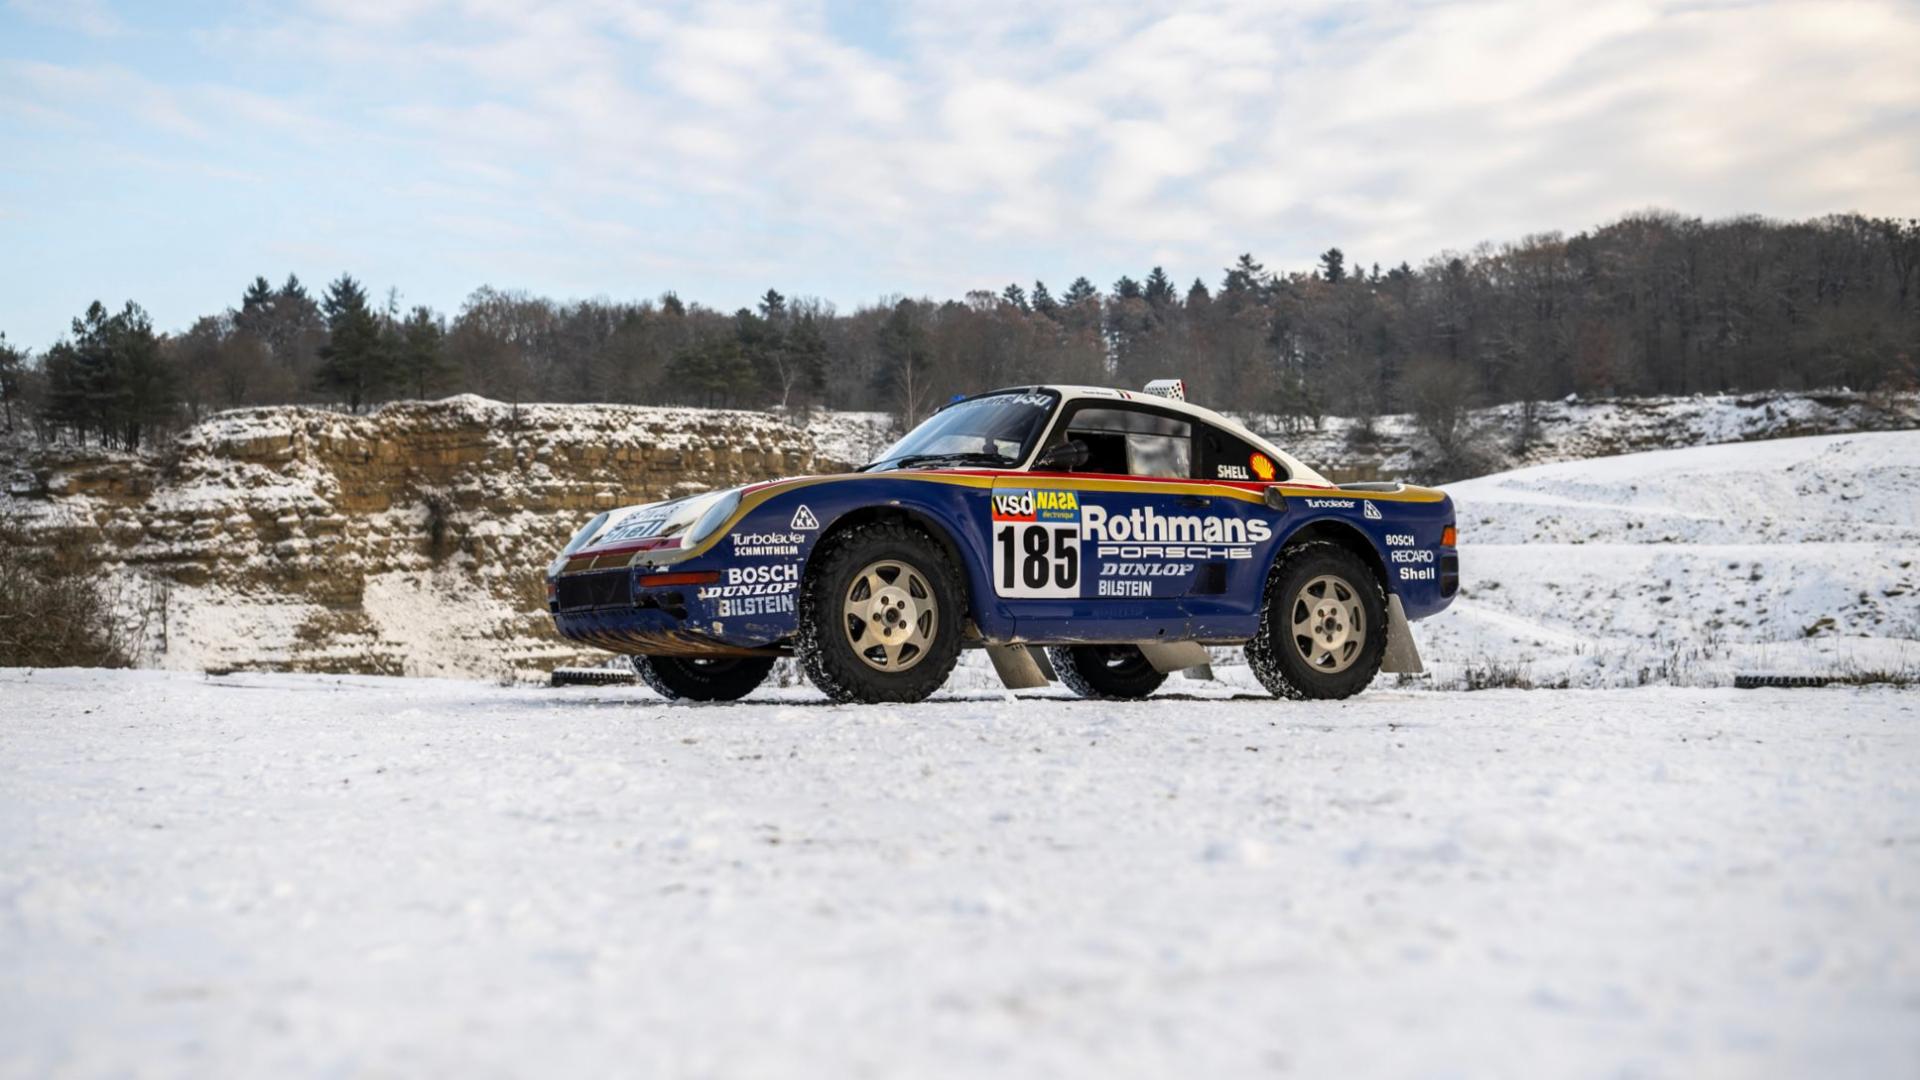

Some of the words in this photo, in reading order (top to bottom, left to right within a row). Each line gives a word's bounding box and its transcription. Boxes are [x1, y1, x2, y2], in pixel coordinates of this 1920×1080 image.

[1217, 464, 1249, 479] SHELL
[993, 490, 1034, 516] vsd
[1081, 505, 1272, 542] Rothmans
[731, 532, 805, 546] Turbolader
[1385, 534, 1415, 546] BOSCH
[734, 546, 798, 557] SCHMITTHELM
[997, 525, 1078, 589] 185
[1097, 546, 1253, 559] PORSCHE
[1391, 550, 1433, 562] RECARO
[728, 564, 799, 584] BOSCH
[1100, 563, 1194, 576] DUNLOP
[1400, 567, 1435, 580] Shell
[704, 582, 798, 598] DUNLOP
[1098, 579, 1152, 597] BILSTEIN
[718, 594, 794, 617] BILSTEIN
